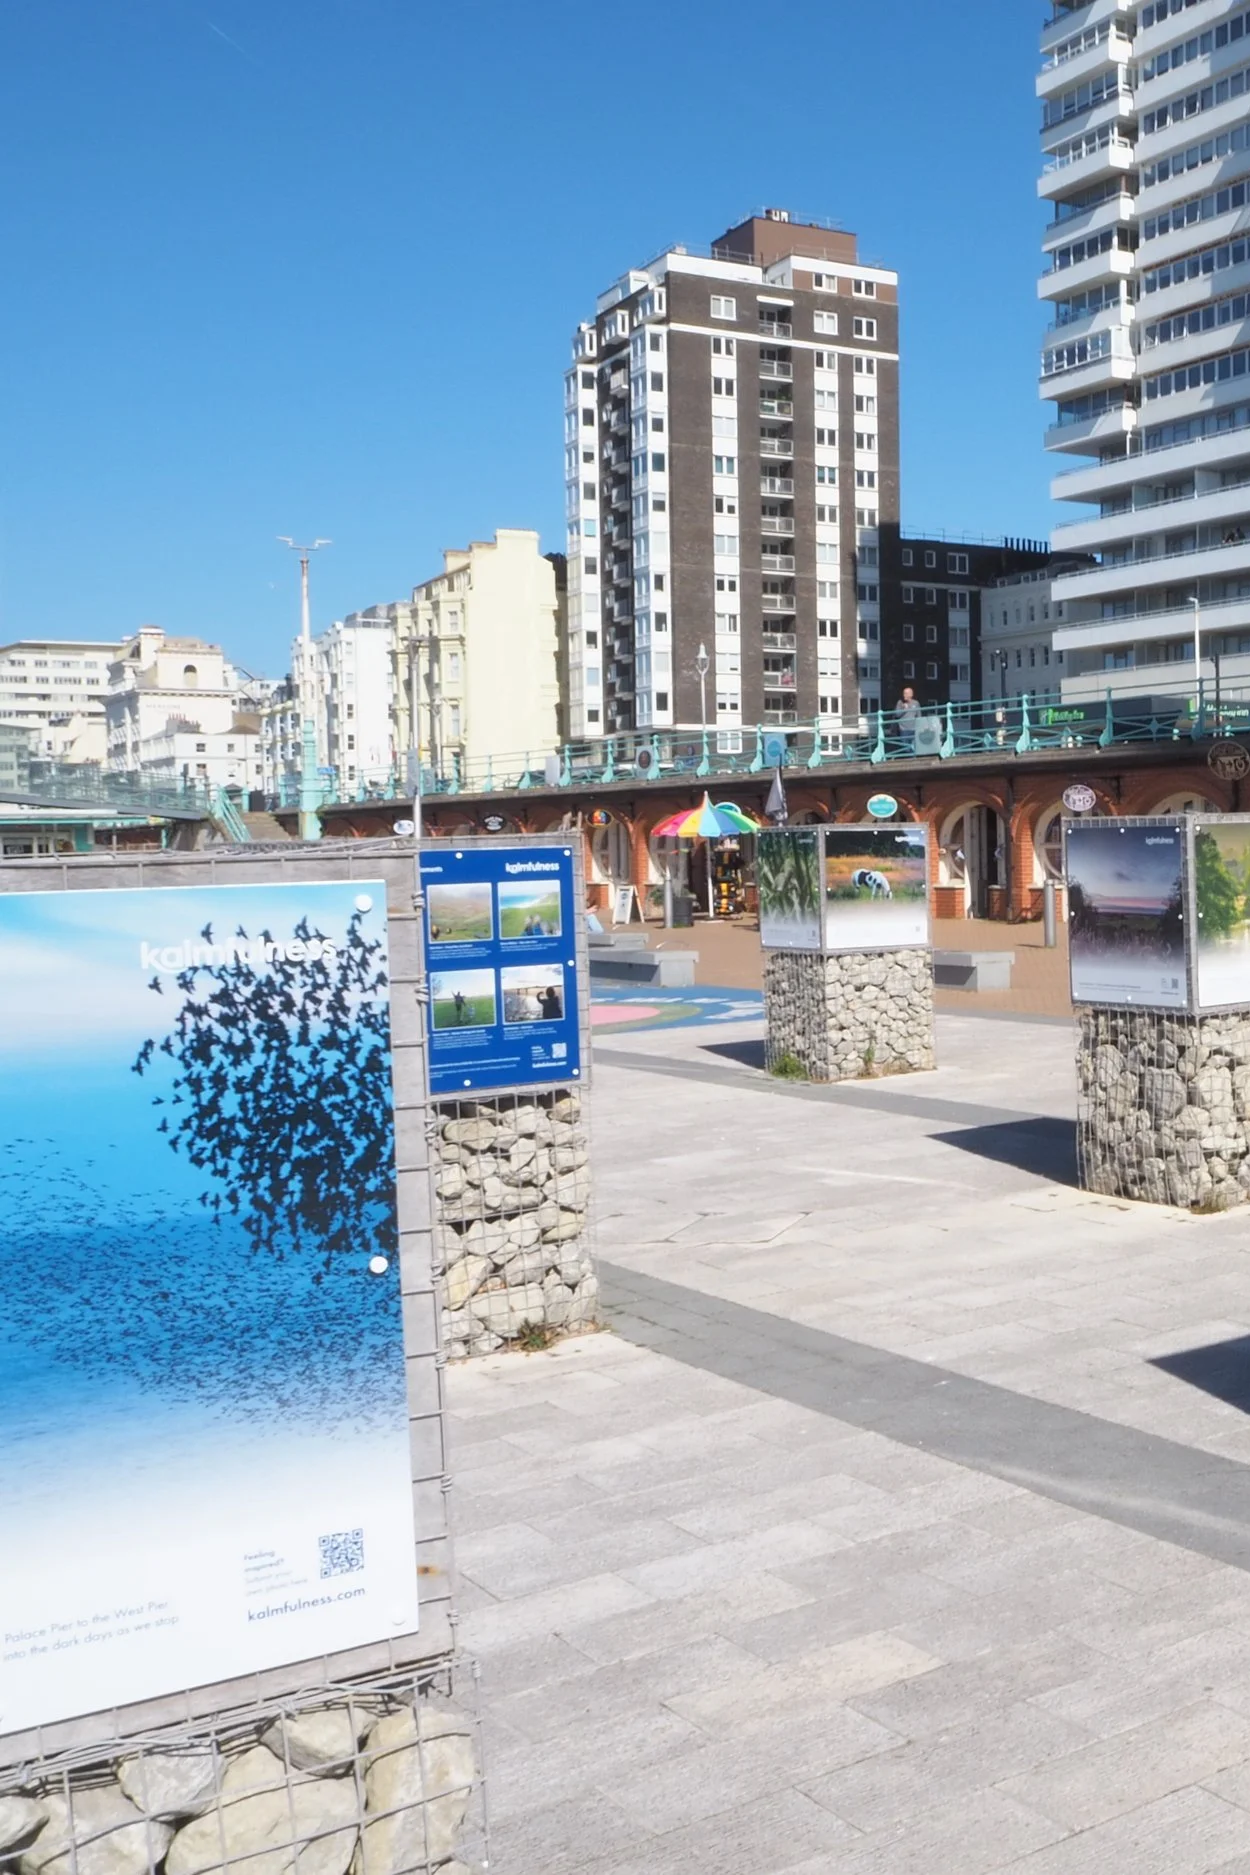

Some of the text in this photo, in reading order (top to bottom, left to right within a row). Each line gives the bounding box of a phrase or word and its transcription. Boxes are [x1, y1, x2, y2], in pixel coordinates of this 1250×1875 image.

[139, 936, 337, 974] kalmfulness
[4, 1600, 169, 1644] Palace Pier to the West Pier
[247, 1587, 366, 1622] kalmfulness.com
[3, 1615, 180, 1663] into the dark days as we stop
